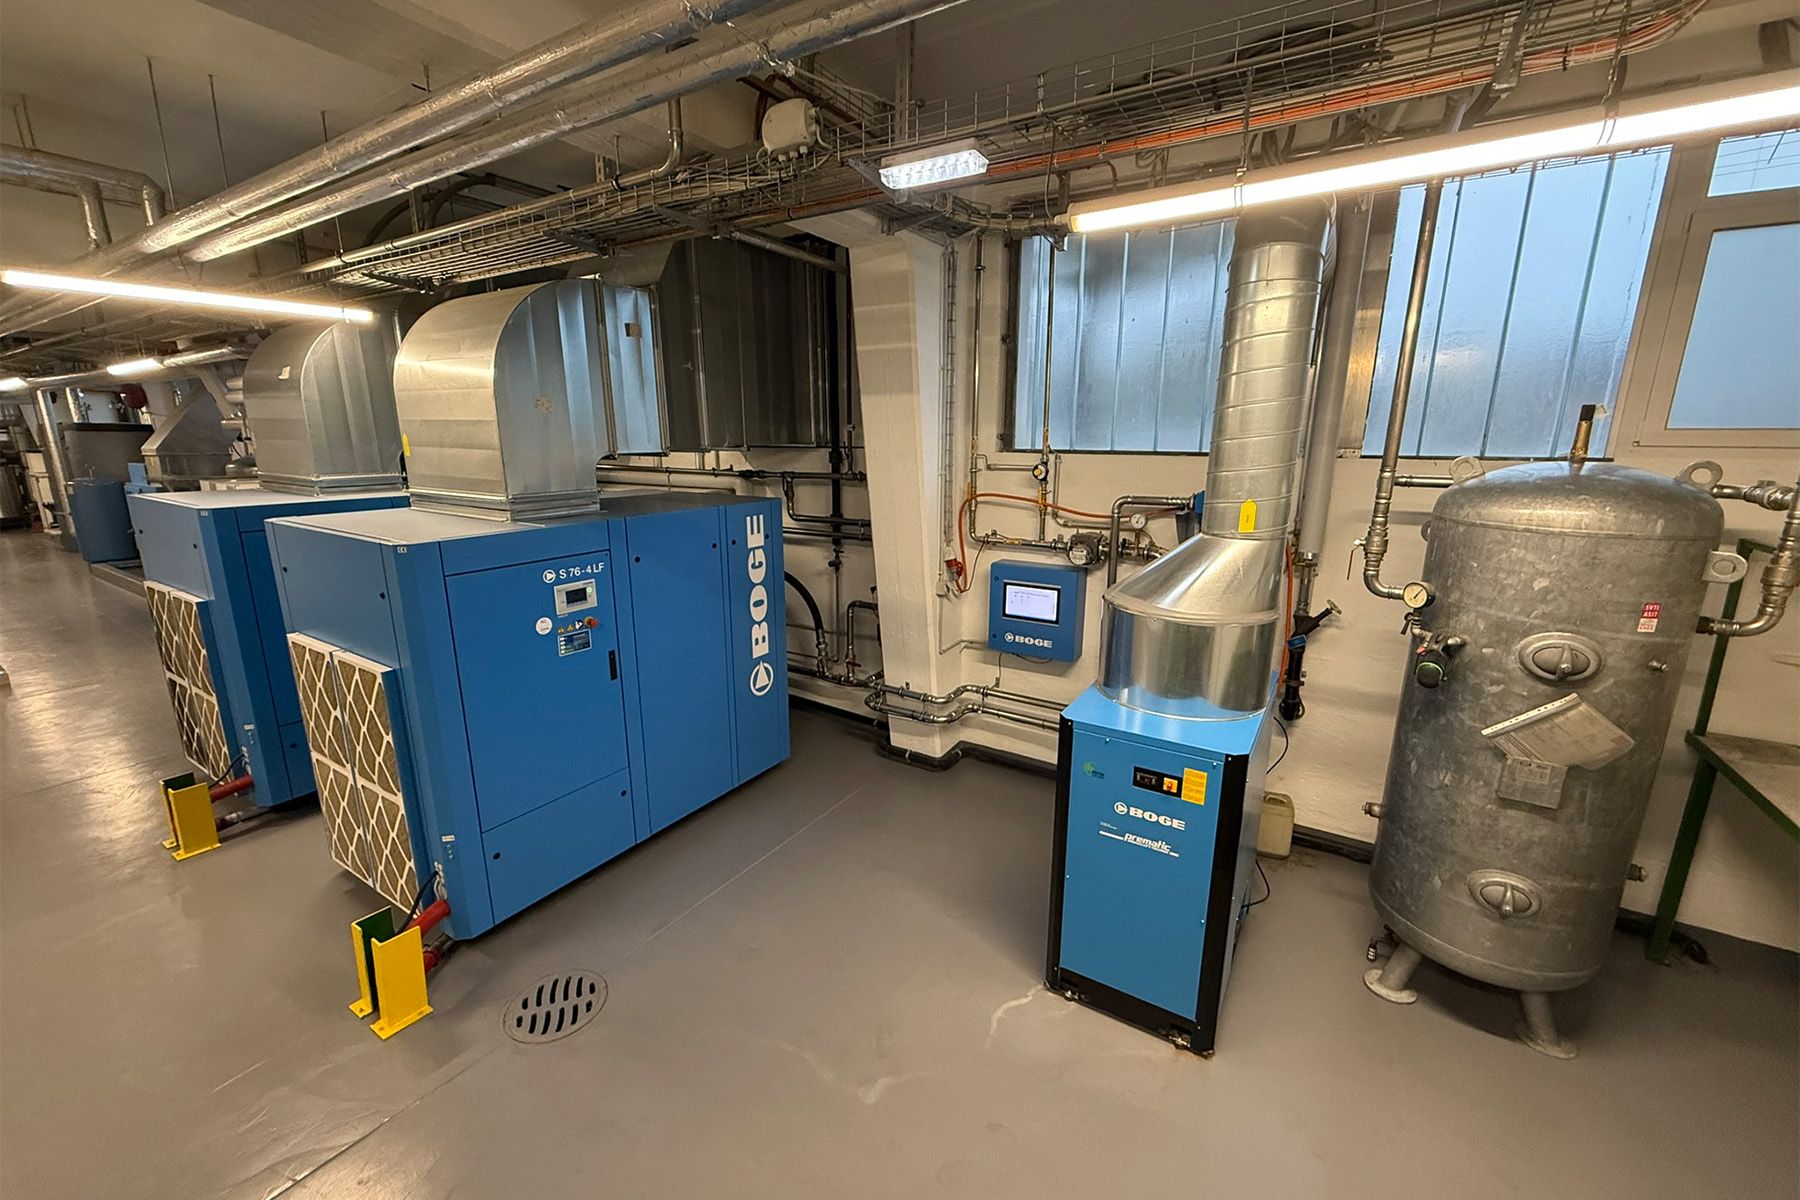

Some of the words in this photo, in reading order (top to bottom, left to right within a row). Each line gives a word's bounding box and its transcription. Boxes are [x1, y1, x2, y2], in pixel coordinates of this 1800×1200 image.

[559, 568, 567, 579] S
[746, 514, 769, 659] BOGE
[1015, 635, 1053, 648] BOGE
[1129, 806, 1186, 831] BOGE
[1124, 832, 1171, 852] prematic
